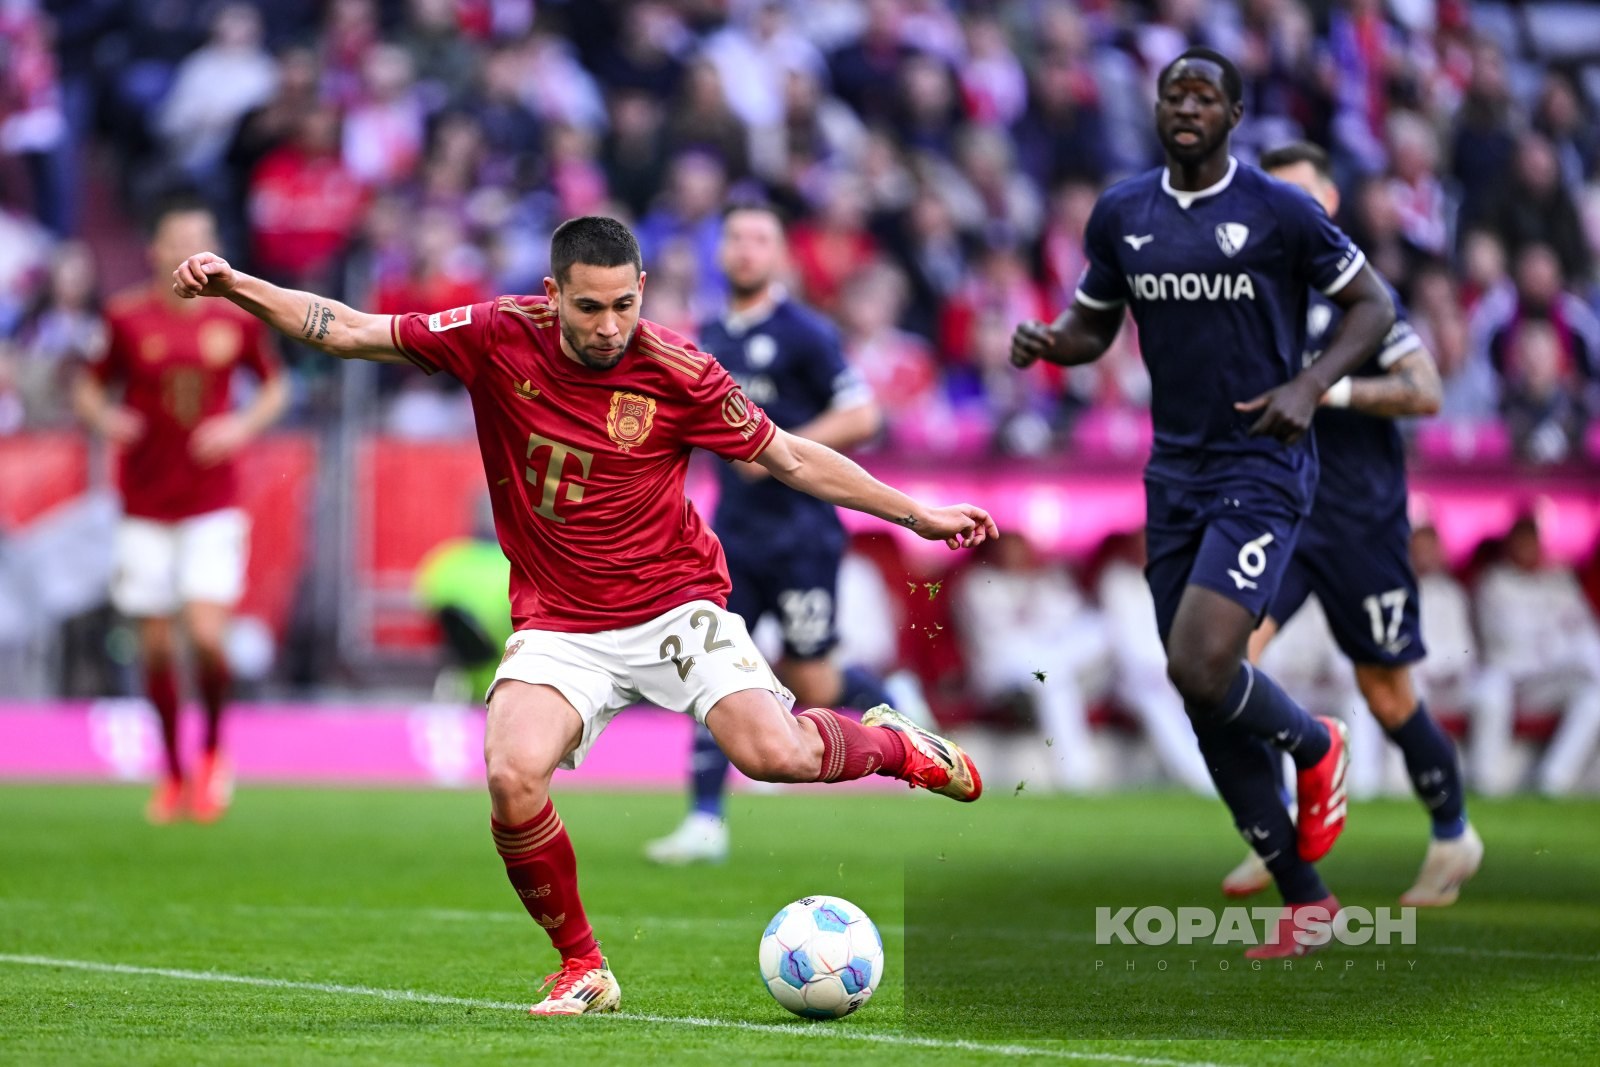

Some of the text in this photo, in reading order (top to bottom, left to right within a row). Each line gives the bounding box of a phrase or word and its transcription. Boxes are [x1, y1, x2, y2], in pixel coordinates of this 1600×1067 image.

[622, 402, 644, 417] 125
[526, 432, 594, 524] T
[1238, 532, 1274, 577] 6
[659, 609, 735, 682] 22
[1363, 588, 1408, 646] 17
